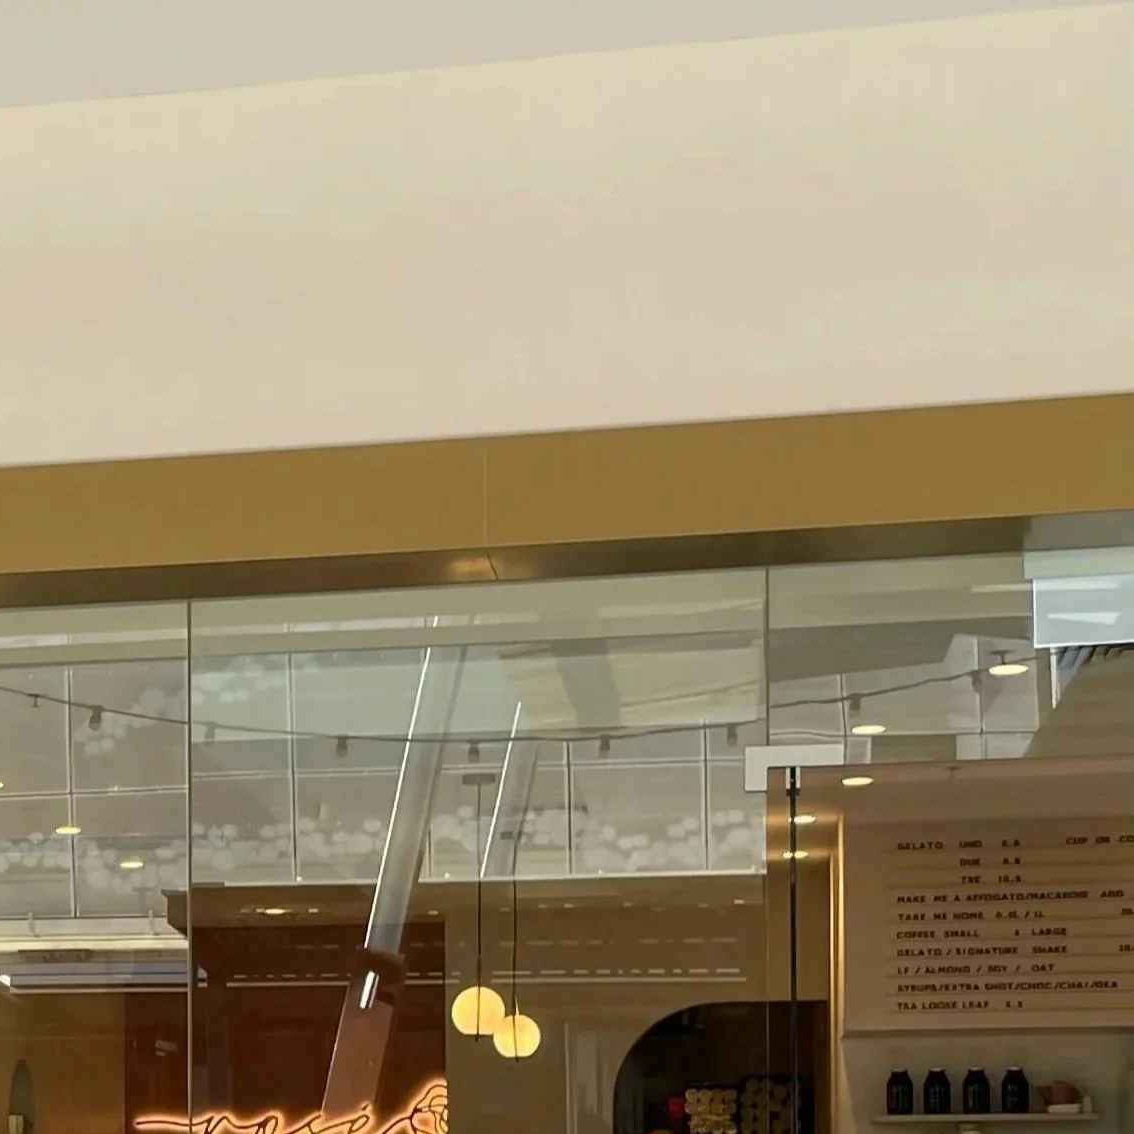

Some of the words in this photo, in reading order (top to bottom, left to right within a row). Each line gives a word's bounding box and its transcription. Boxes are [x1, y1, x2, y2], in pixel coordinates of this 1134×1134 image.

[897, 841, 943, 850] GELATO
[897, 895, 926, 903] MAKE
[897, 931, 935, 939] COFFEE
[944, 930, 979, 938] SMALL
[1032, 928, 1066, 936] LARGE
[897, 948, 942, 956] GELATO
[956, 947, 1018, 955] SIGNATURE
[1032, 946, 1067, 954] SHAKE
[925, 966, 970, 974] ALMOND
[1032, 964, 1054, 972] OAT
[898, 1002, 917, 1011] TEA
[922, 1001, 957, 1009] LOOSE
